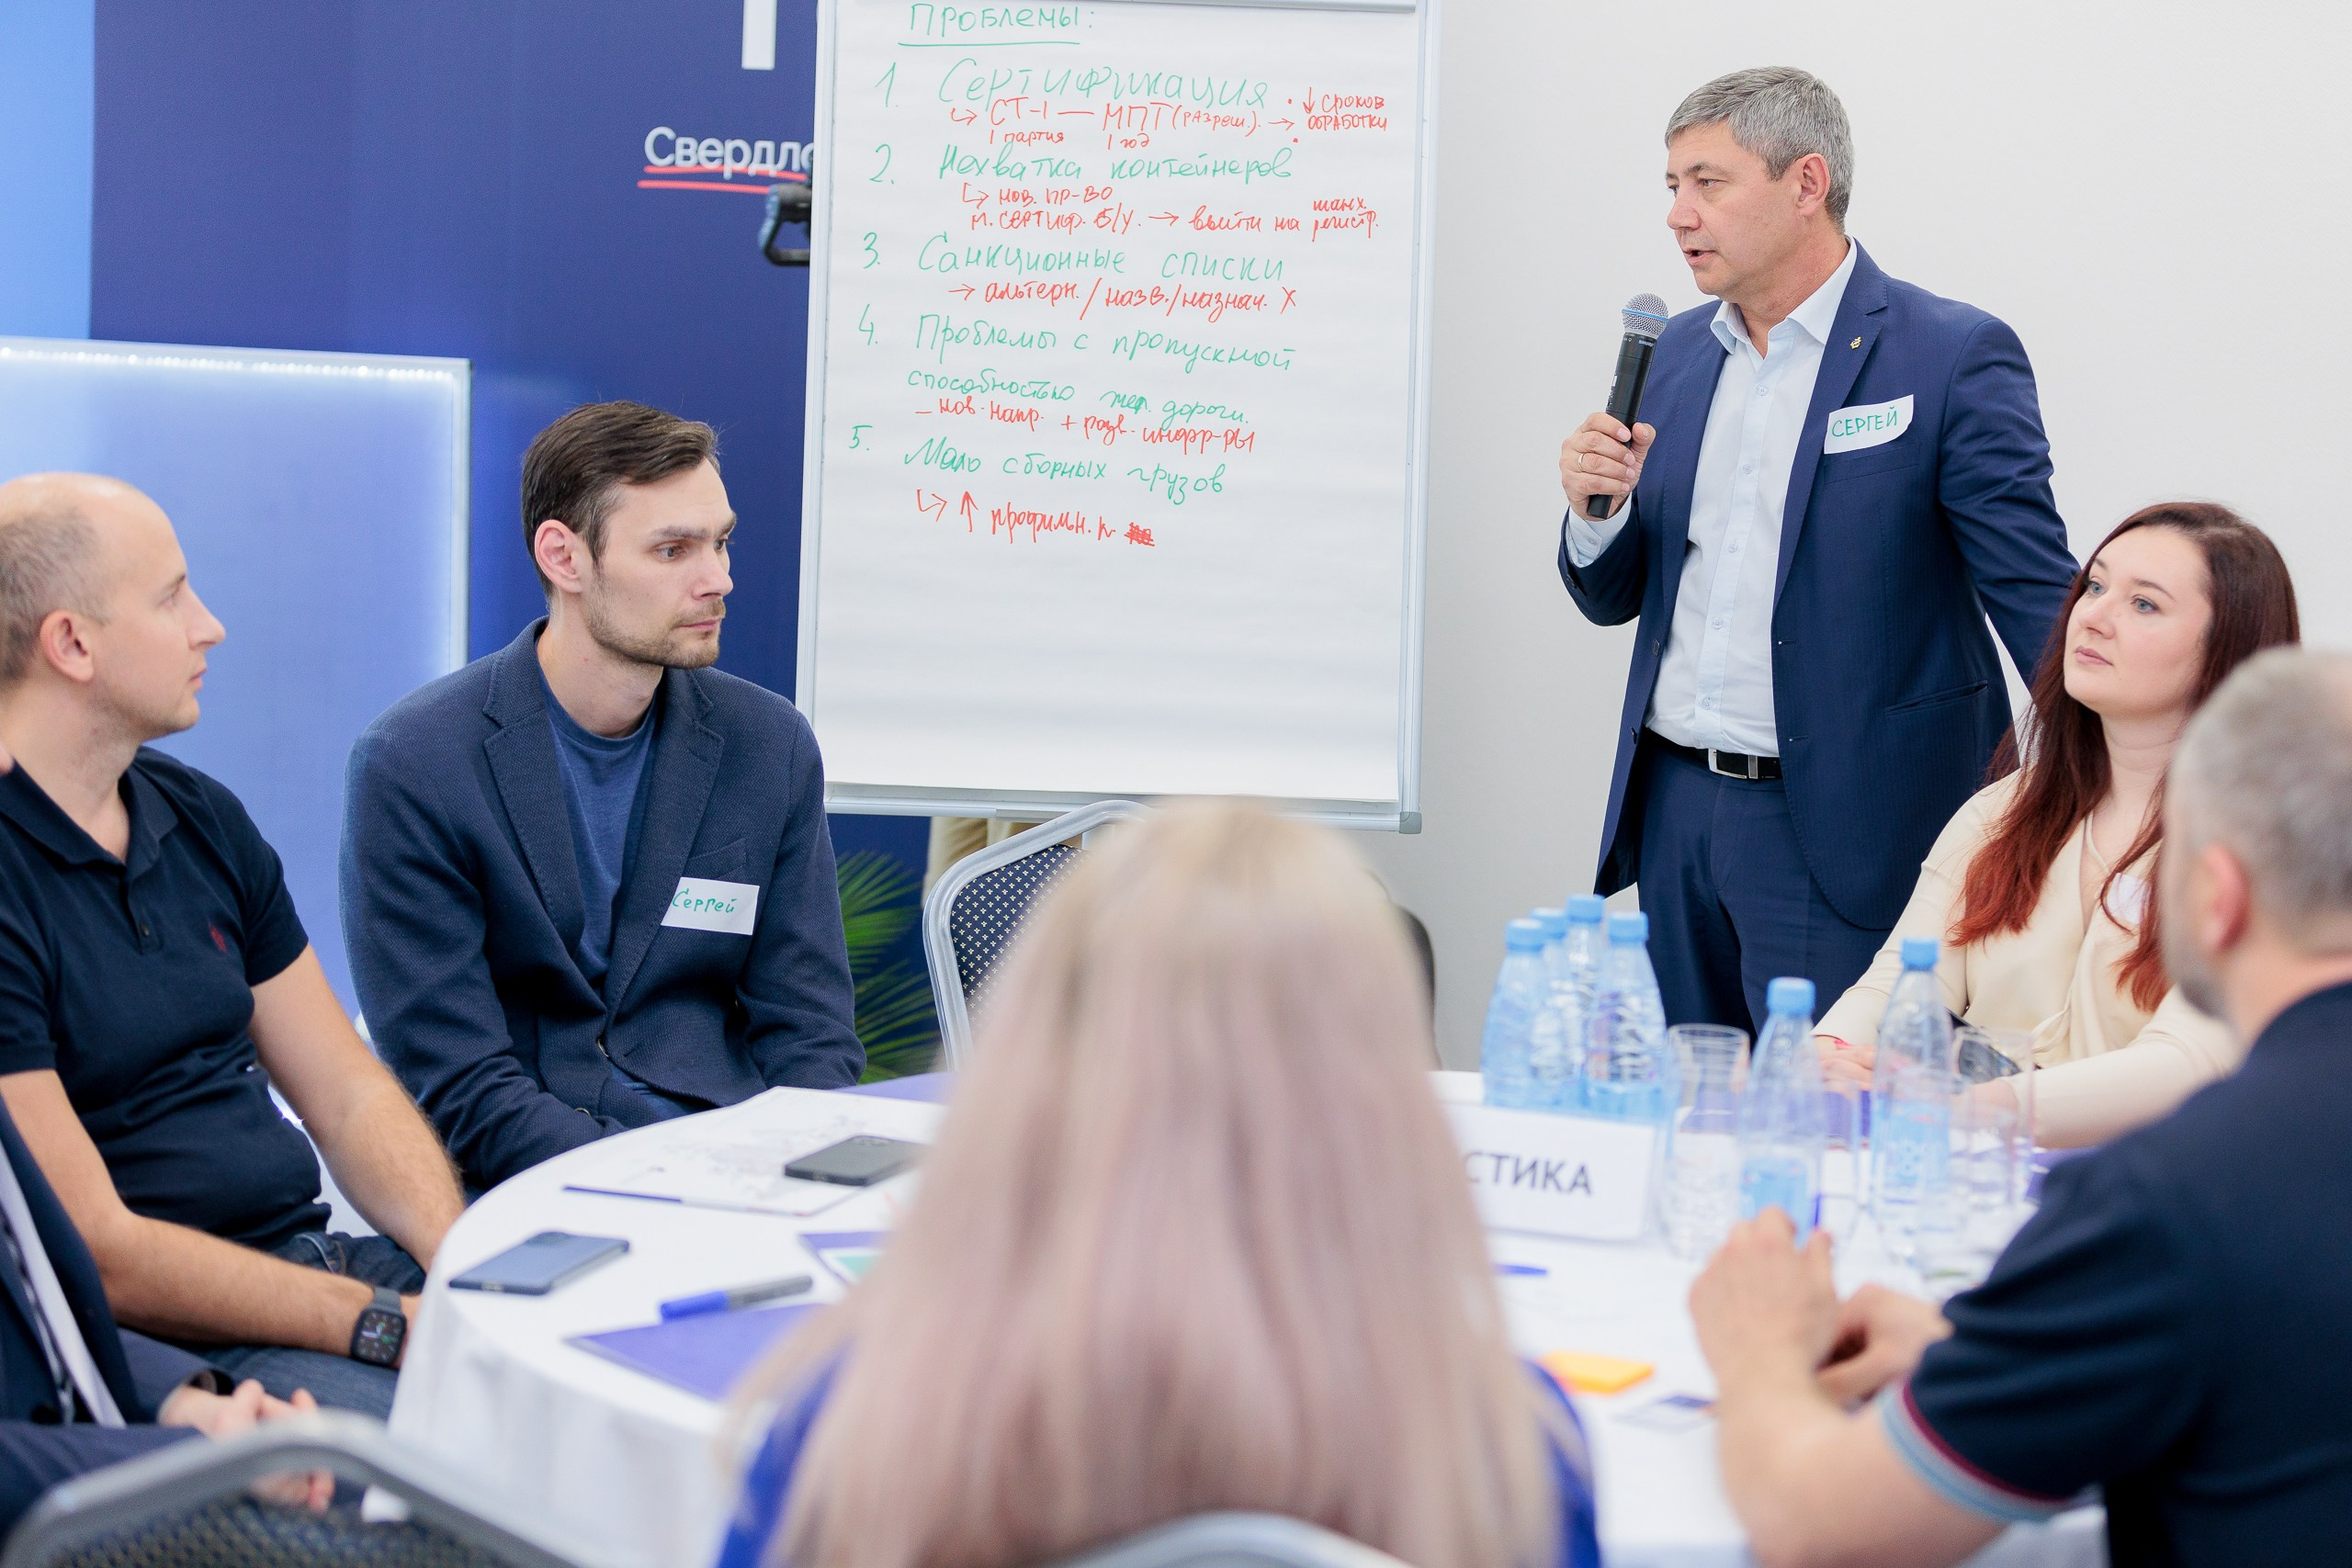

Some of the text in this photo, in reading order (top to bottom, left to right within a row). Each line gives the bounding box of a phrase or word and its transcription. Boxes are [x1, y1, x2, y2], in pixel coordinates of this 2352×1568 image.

[938, 58, 1268, 112] Сертификация
[1004, 130, 1065, 147] партия
[869, 141, 1293, 185] 2. Нехватка контейнеров
[1273, 213, 1302, 232] на
[862, 231, 1283, 282] 3. Санкционные списки
[857, 303, 1297, 375] 4. Проблемы с пропускной
[907, 367, 1075, 401] способностью
[1831, 405, 1898, 438] СЕРГЕЙ
[848, 424, 874, 452] 5.
[904, 436, 982, 474] Мало
[1126, 462, 1227, 506] грузов
[672, 887, 738, 913] Сергей
[1464, 1150, 1593, 1196] СТИКА
